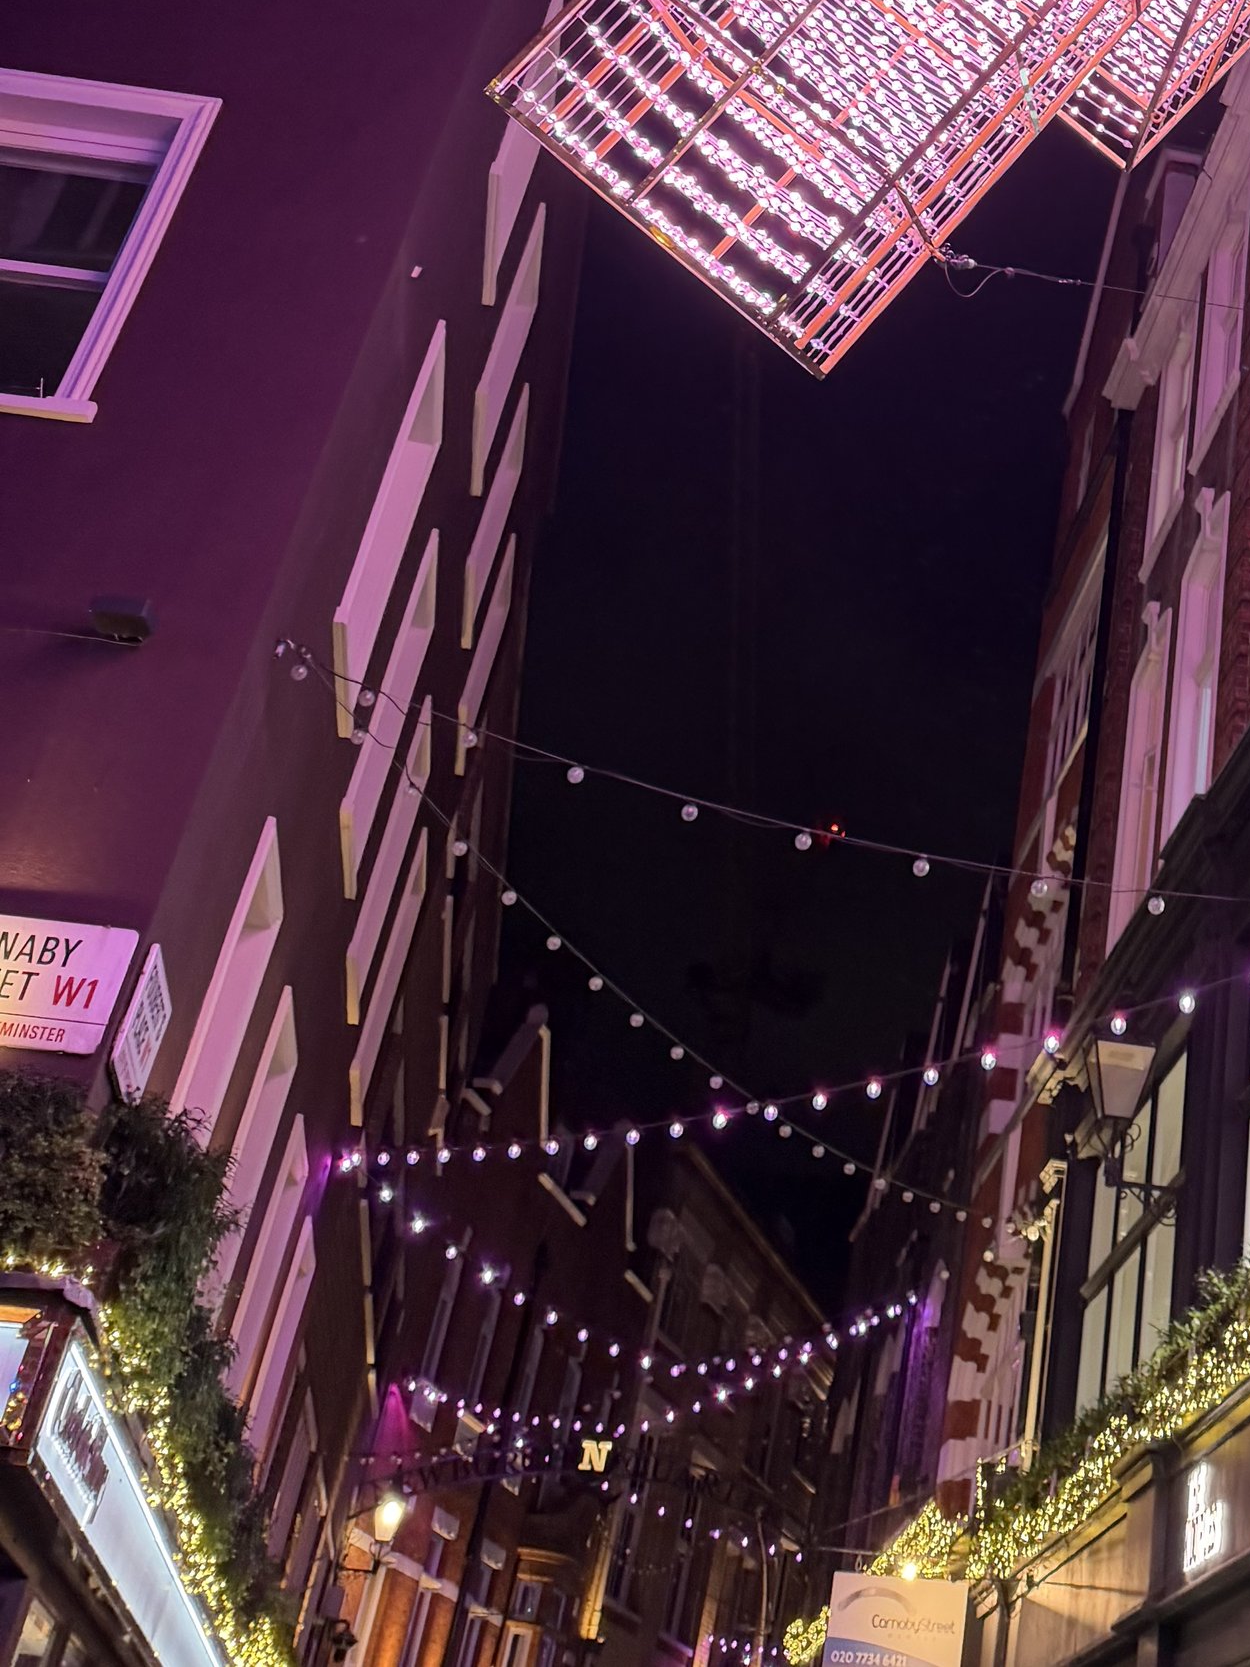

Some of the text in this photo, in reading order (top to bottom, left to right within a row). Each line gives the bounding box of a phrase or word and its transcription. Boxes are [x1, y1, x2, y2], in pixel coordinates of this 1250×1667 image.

[52, 974, 100, 1009] W1
[0, 1020, 65, 1043] MINSTER
[577, 1439, 613, 1473] N
[830, 1650, 854, 1664] 020
[855, 1652, 881, 1666] 7734
